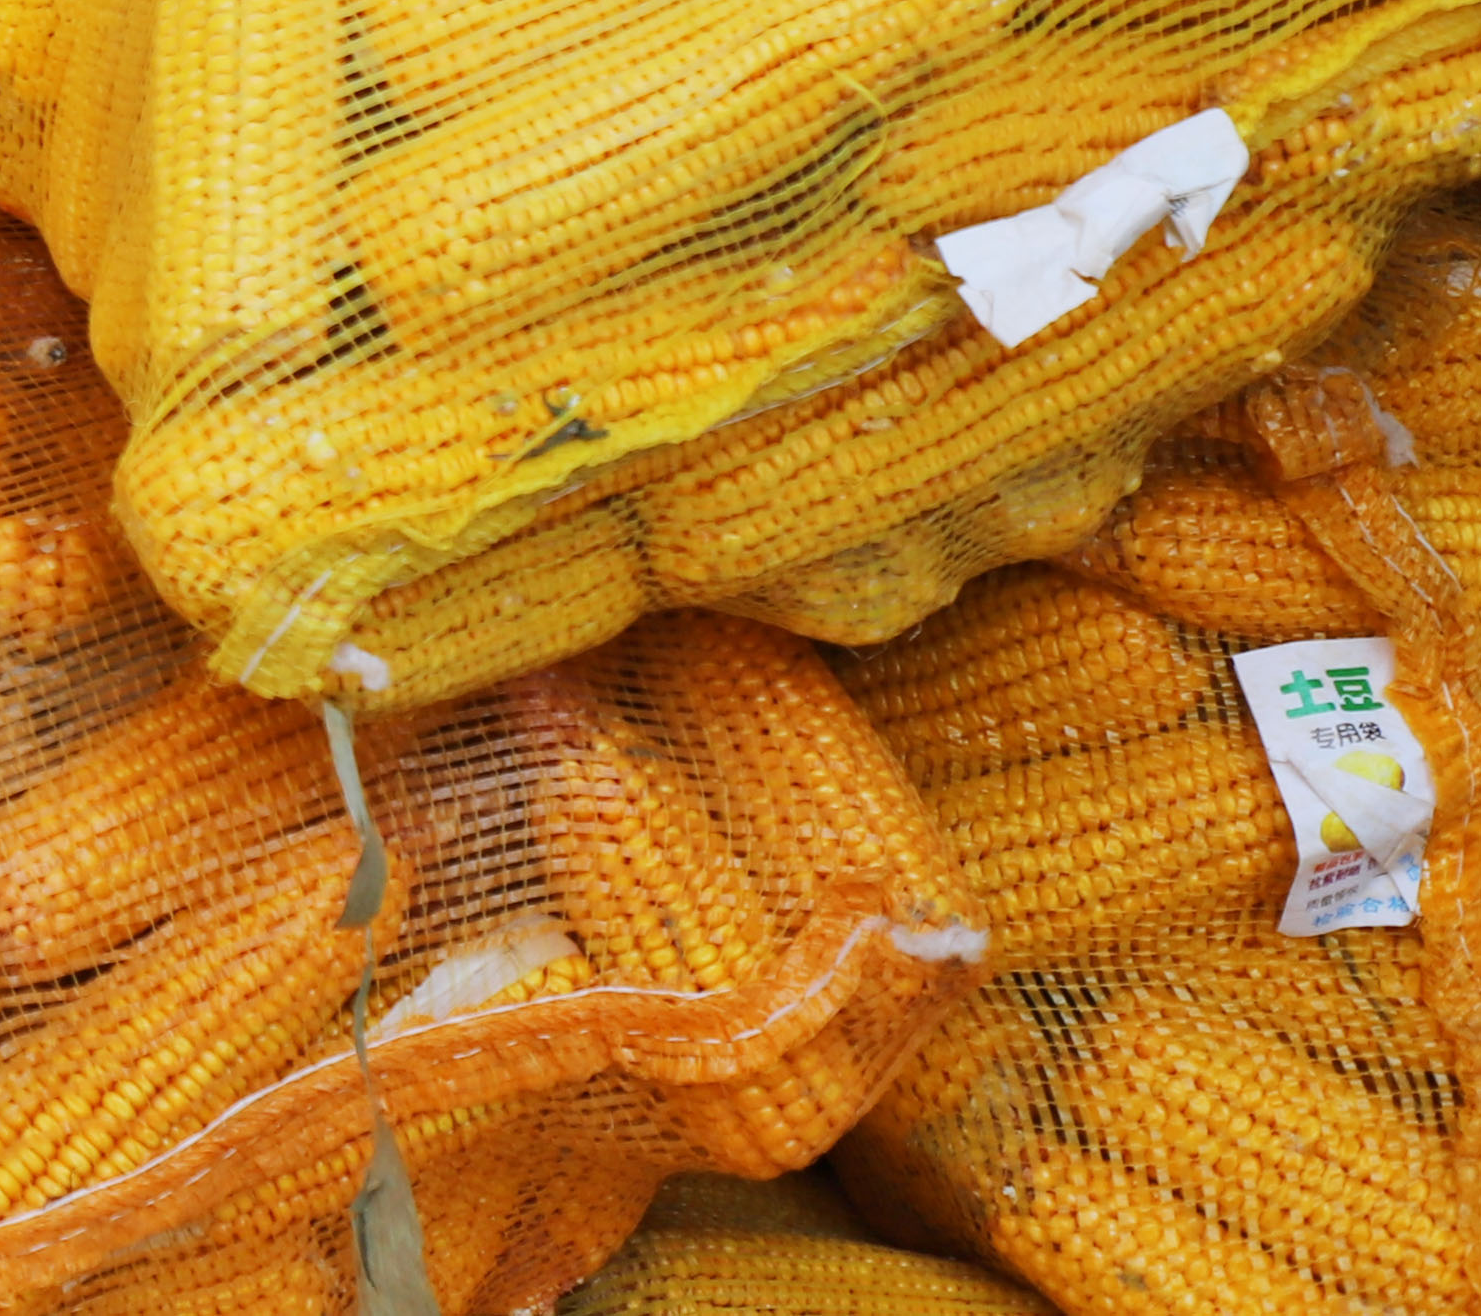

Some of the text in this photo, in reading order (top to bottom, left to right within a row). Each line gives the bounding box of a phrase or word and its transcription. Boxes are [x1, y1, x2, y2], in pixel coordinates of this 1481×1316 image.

[1280, 666, 1384, 718] 土豆
[1310, 721, 1388, 750] 专用袋
